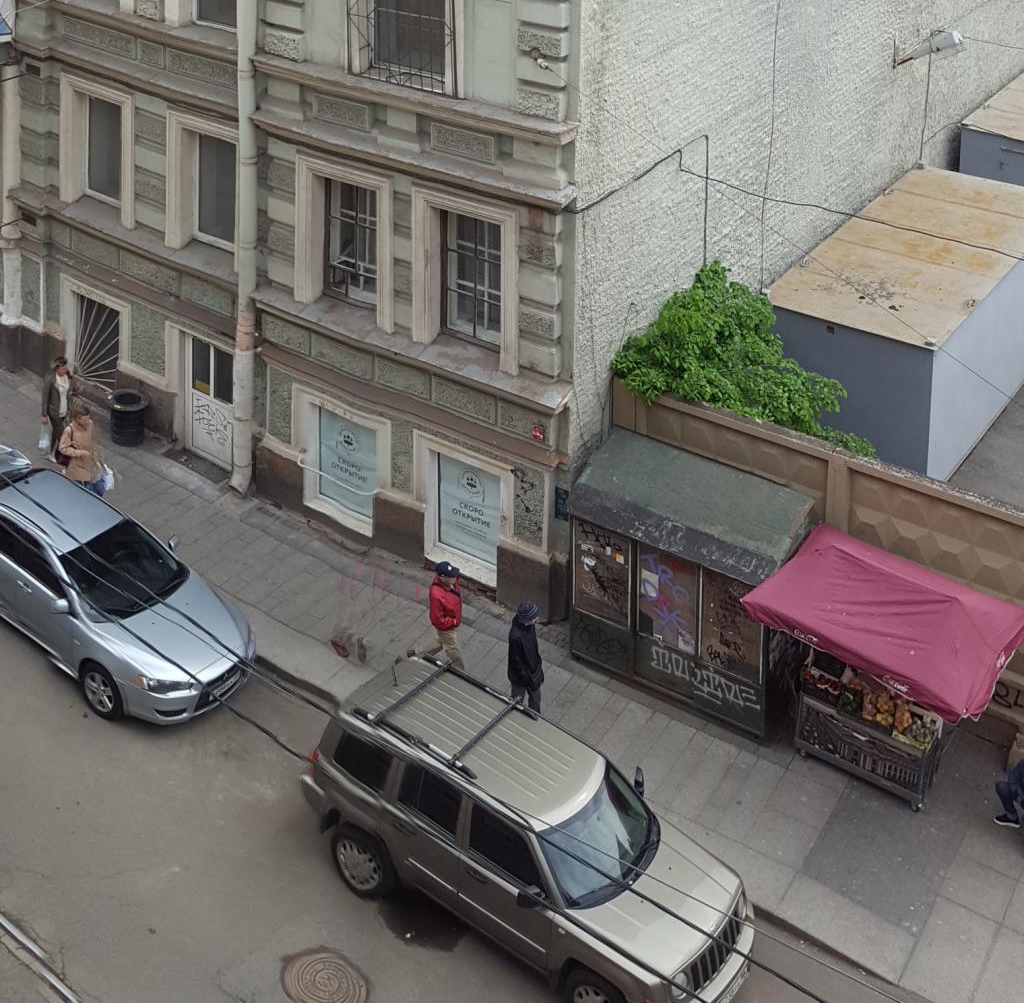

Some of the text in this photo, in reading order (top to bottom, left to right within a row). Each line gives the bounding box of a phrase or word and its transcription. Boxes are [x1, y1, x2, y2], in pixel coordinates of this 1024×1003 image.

[330, 461, 368, 483] ОТКРЫТИЕ
[337, 456, 361, 472] СКОРО
[459, 501, 484, 516] СКОРО
[451, 508, 491, 528] ОТКРЫТИЕ
